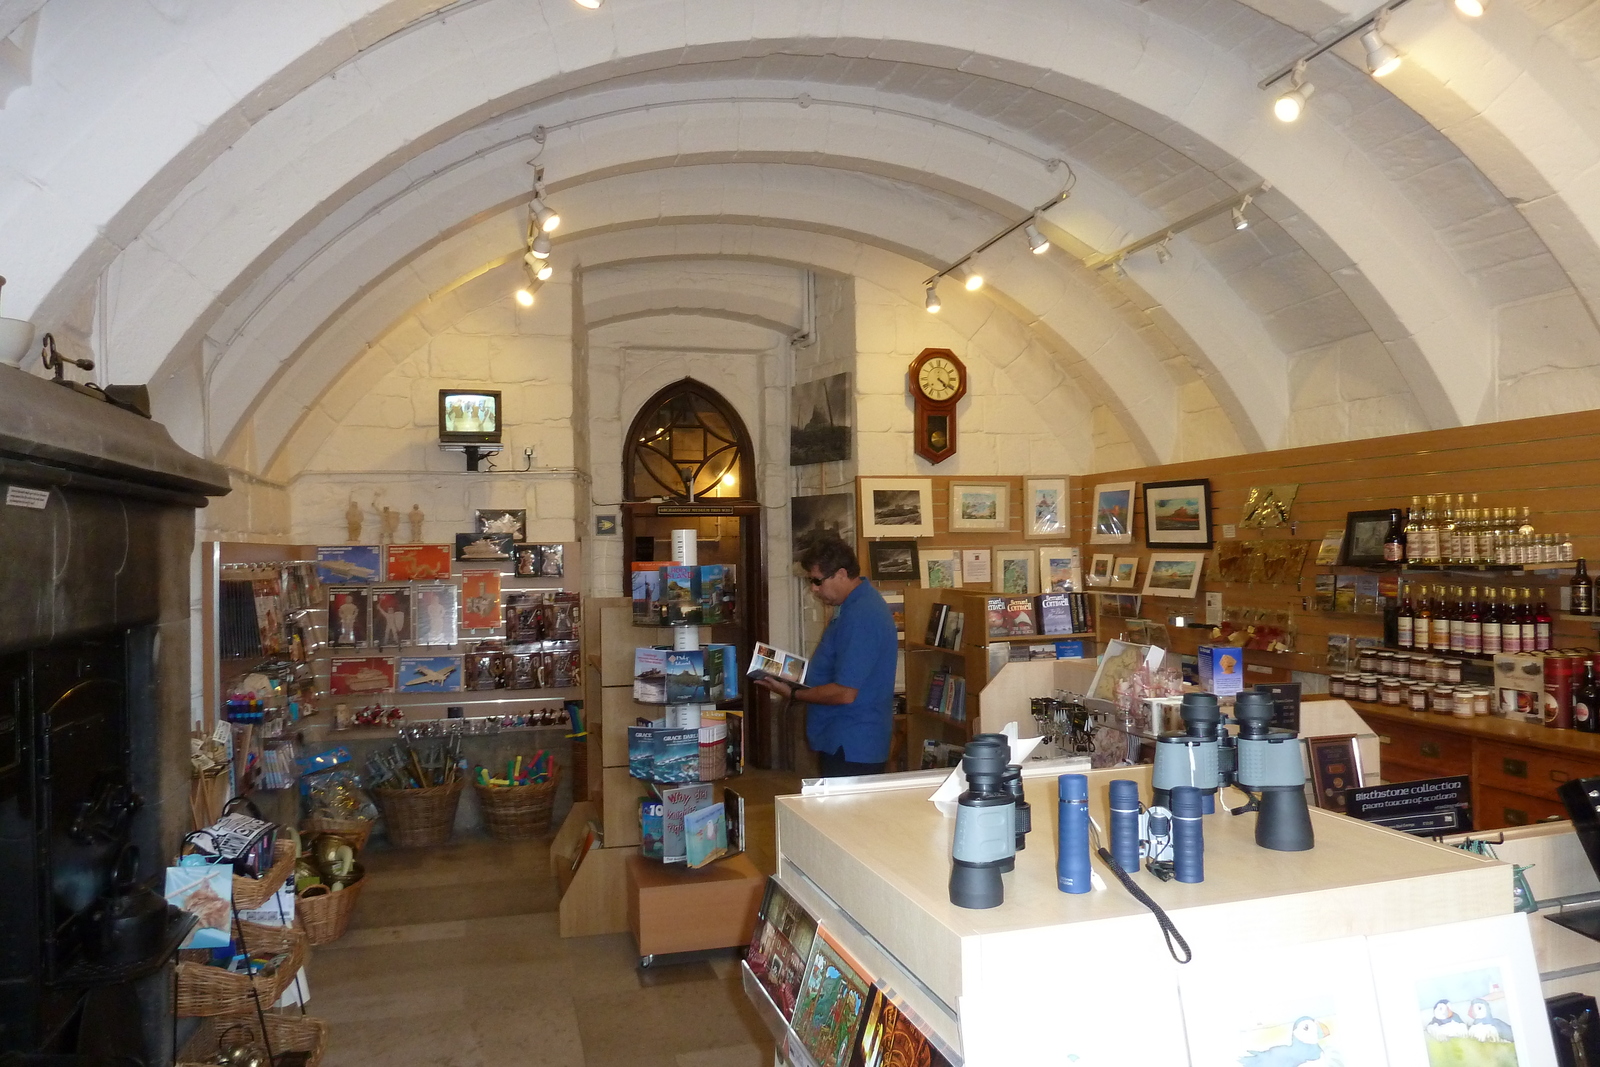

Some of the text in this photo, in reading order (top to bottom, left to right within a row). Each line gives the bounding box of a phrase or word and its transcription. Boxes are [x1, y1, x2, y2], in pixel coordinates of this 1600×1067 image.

[1007, 603, 1032, 612] Cornwell
[1042, 599, 1069, 608] Cornwell
[667, 789, 708, 806] Why did
[1355, 781, 1461, 801] Birthstone collection
[1361, 803, 1384, 812] from
[1412, 796, 1422, 805] of
